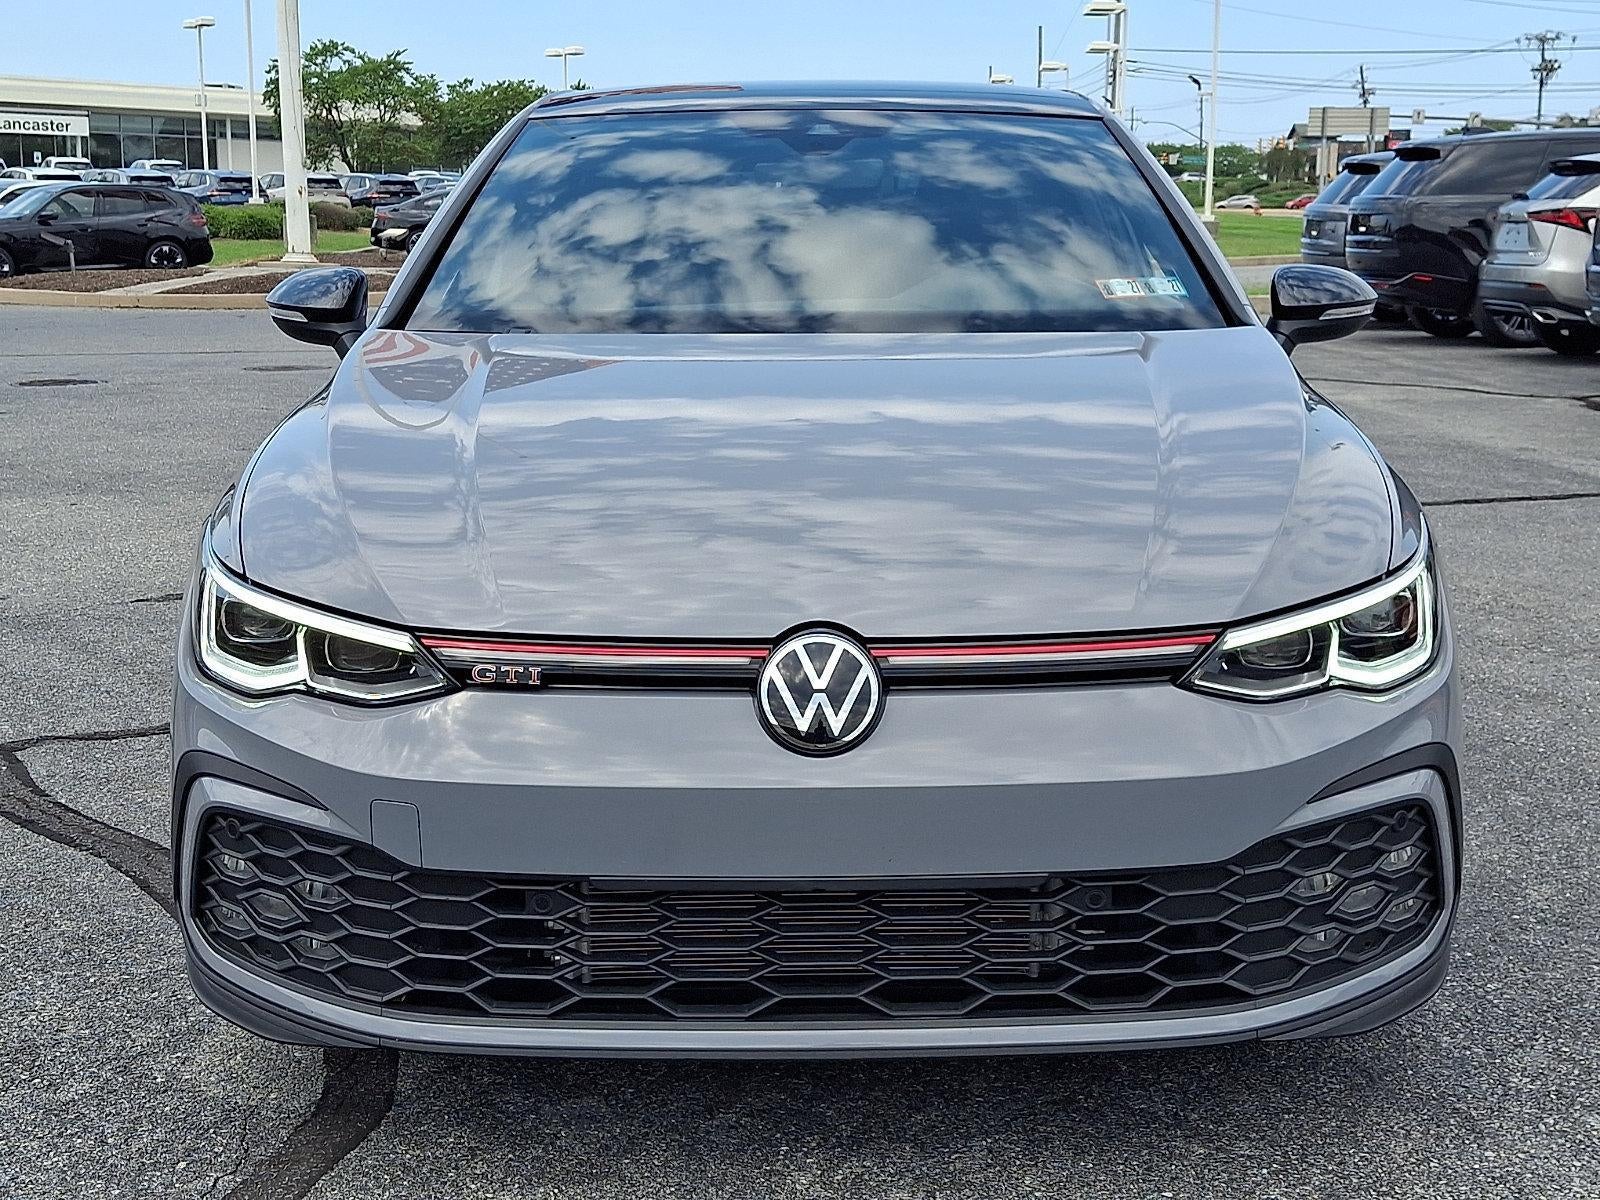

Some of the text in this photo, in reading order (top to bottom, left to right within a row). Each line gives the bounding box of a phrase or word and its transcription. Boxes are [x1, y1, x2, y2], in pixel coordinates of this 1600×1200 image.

[0, 118, 71, 132] ancaster
[471, 664, 542, 685] GTI
[766, 638, 873, 738] VW
